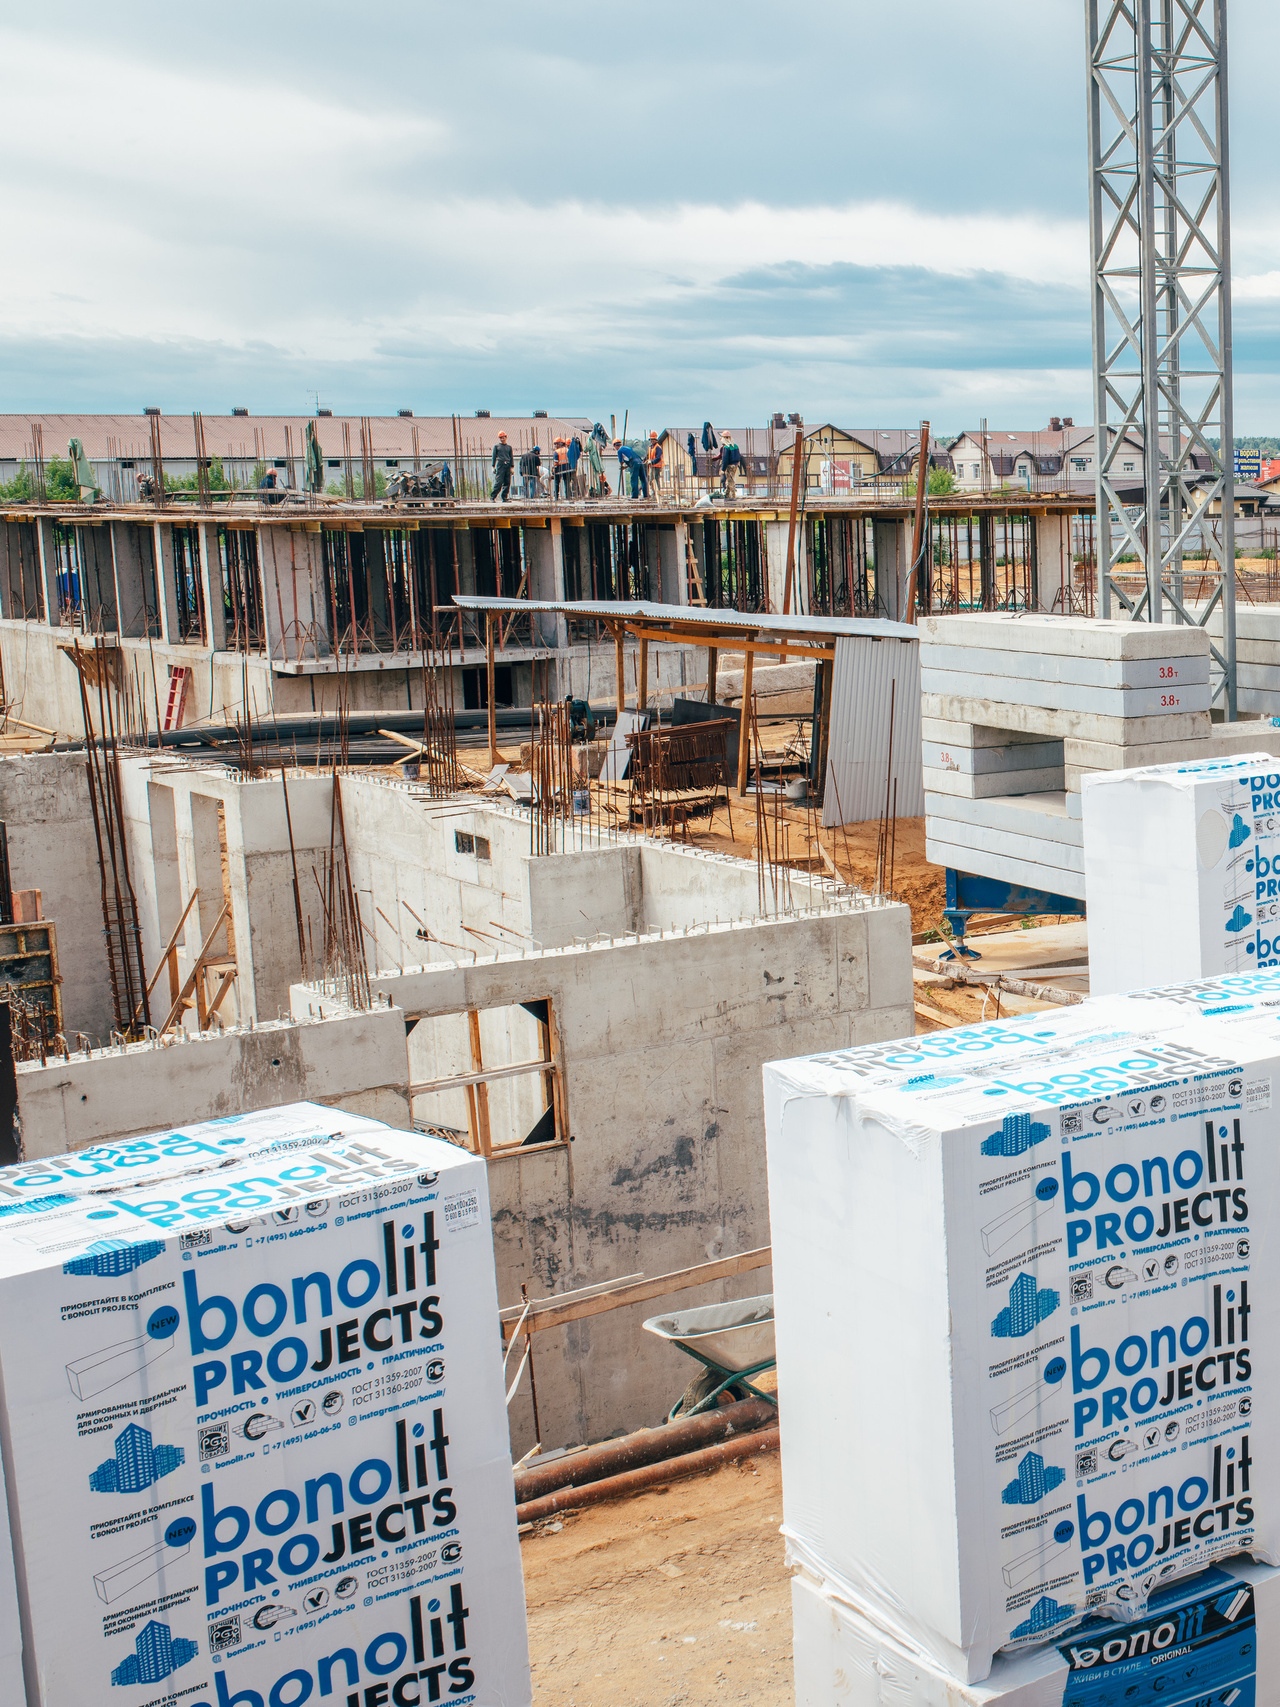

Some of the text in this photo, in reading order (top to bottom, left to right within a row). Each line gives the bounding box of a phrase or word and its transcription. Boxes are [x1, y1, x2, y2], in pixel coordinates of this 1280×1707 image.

[1004, 1043, 1209, 1095] bonolit
[1036, 1055, 1236, 1105] PROJECTS
[1193, 1066, 1244, 1082] ПРАКТИЧНОСТЬ
[108, 1142, 391, 1218] bonolit
[1023, 1160, 1057, 1174] КОМПЛЕКСЕ
[1061, 1118, 1245, 1214] bonolit
[147, 1157, 420, 1229] PROJECTS
[339, 1197, 361, 1209] ГОСТ
[362, 1183, 413, 1203] 31360-2007
[1038, 1184, 1057, 1195] NEW
[346, 1191, 440, 1223] instagram.com/bonolit/
[1066, 1187, 1249, 1258] PROJECTS
[266, 1232, 287, 1244] (495)
[289, 1222, 327, 1238] 660-06-50
[197, 1242, 238, 1258] bonolit.ru
[1069, 1226, 1250, 1272] ПРОЧНОСТЬ УНИВЕРСАЛЬНОСТЬ ПРАКТИЧНОСТЬ
[61, 1296, 119, 1312] ПРИОБРЕТАЙТЕ
[128, 1281, 176, 1302] КОМПЛЕКСЕ
[183, 1210, 440, 1356] bonolit
[68, 1303, 139, 1320] BONOLIT PROJECTS
[1082, 1299, 1116, 1312] bonolit.ru
[151, 1316, 176, 1331] NEW
[1070, 1280, 1251, 1394] bonolit
[193, 1295, 444, 1407] PROJECTS
[197, 1343, 445, 1424] ПРОЧНОСТЬ УНИВЕРСАЛЬНОСТЬ ПРАКТИЧНОСТЬ
[351, 1366, 423, 1395] ГОСТ 31359-2007
[1046, 1364, 1064, 1377] NEW
[77, 1384, 187, 1420] АРМИРОВАННЫЕ ПЕРЕМЫЧКИ
[352, 1378, 423, 1407] ГОСТ 31360-2007
[359, 1388, 446, 1422] instagram.com/bonolit/
[1074, 1348, 1252, 1438] PROJECTS
[77, 1420, 92, 1429] ДЛЯ
[94, 1409, 131, 1426] ОКОННЫХ
[140, 1396, 177, 1414] ДВЕРНЫХ
[1075, 1385, 1252, 1451] ПРОЧНОСТЬ УНИВЕРСАЛЬНОСТЬ ПРАКТИЧНОСТЬ
[79, 1423, 113, 1436] ПРОЕМОВ
[272, 1422, 342, 1450] +7 (495) 660-06-50
[215, 1451, 255, 1470] bonolit.ru
[201, 1407, 450, 1558] bonolit
[1077, 1436, 1252, 1551] bonolit
[90, 1513, 141, 1531] ПРИОБРЕТАЙТЕ
[149, 1495, 194, 1514] КОМПЛЕКСЕ
[97, 1514, 158, 1538] BONOLIT PROJECTS
[168, 1525, 193, 1540] NEW
[205, 1488, 457, 1606] PROJECTS
[1056, 1526, 1073, 1537] NEW
[1083, 1497, 1254, 1585] PROJECTS
[207, 1528, 459, 1621] ПРОЧНОСТЬ УНИВЕРСАЛЬНОСТЬ ПРАКТИЧНОСТЬ
[366, 1550, 437, 1579] ГОСТ 31359-2007
[367, 1560, 437, 1589] ГОСТ 31360-2007
[375, 1567, 464, 1602] instagram.com/bonolit/
[102, 1586, 199, 1622] АРМИРОВАННЫЕ ПЕРЕМЫЧКИ
[104, 1596, 190, 1630] ДЛЯ ОКОННЫХ ДВЕРНЫХ
[104, 1622, 135, 1637] ПРОЕМОВ
[284, 1620, 316, 1637] +7 (495)
[1070, 1604, 1207, 1669] bonolit
[226, 1639, 266, 1659] bonolit.ru
[1151, 1645, 1193, 1665] ORIGINAL
[167, 1681, 209, 1701] КОМПЛЕКСЕ
[1072, 1670, 1099, 1684] ЖИВИ
